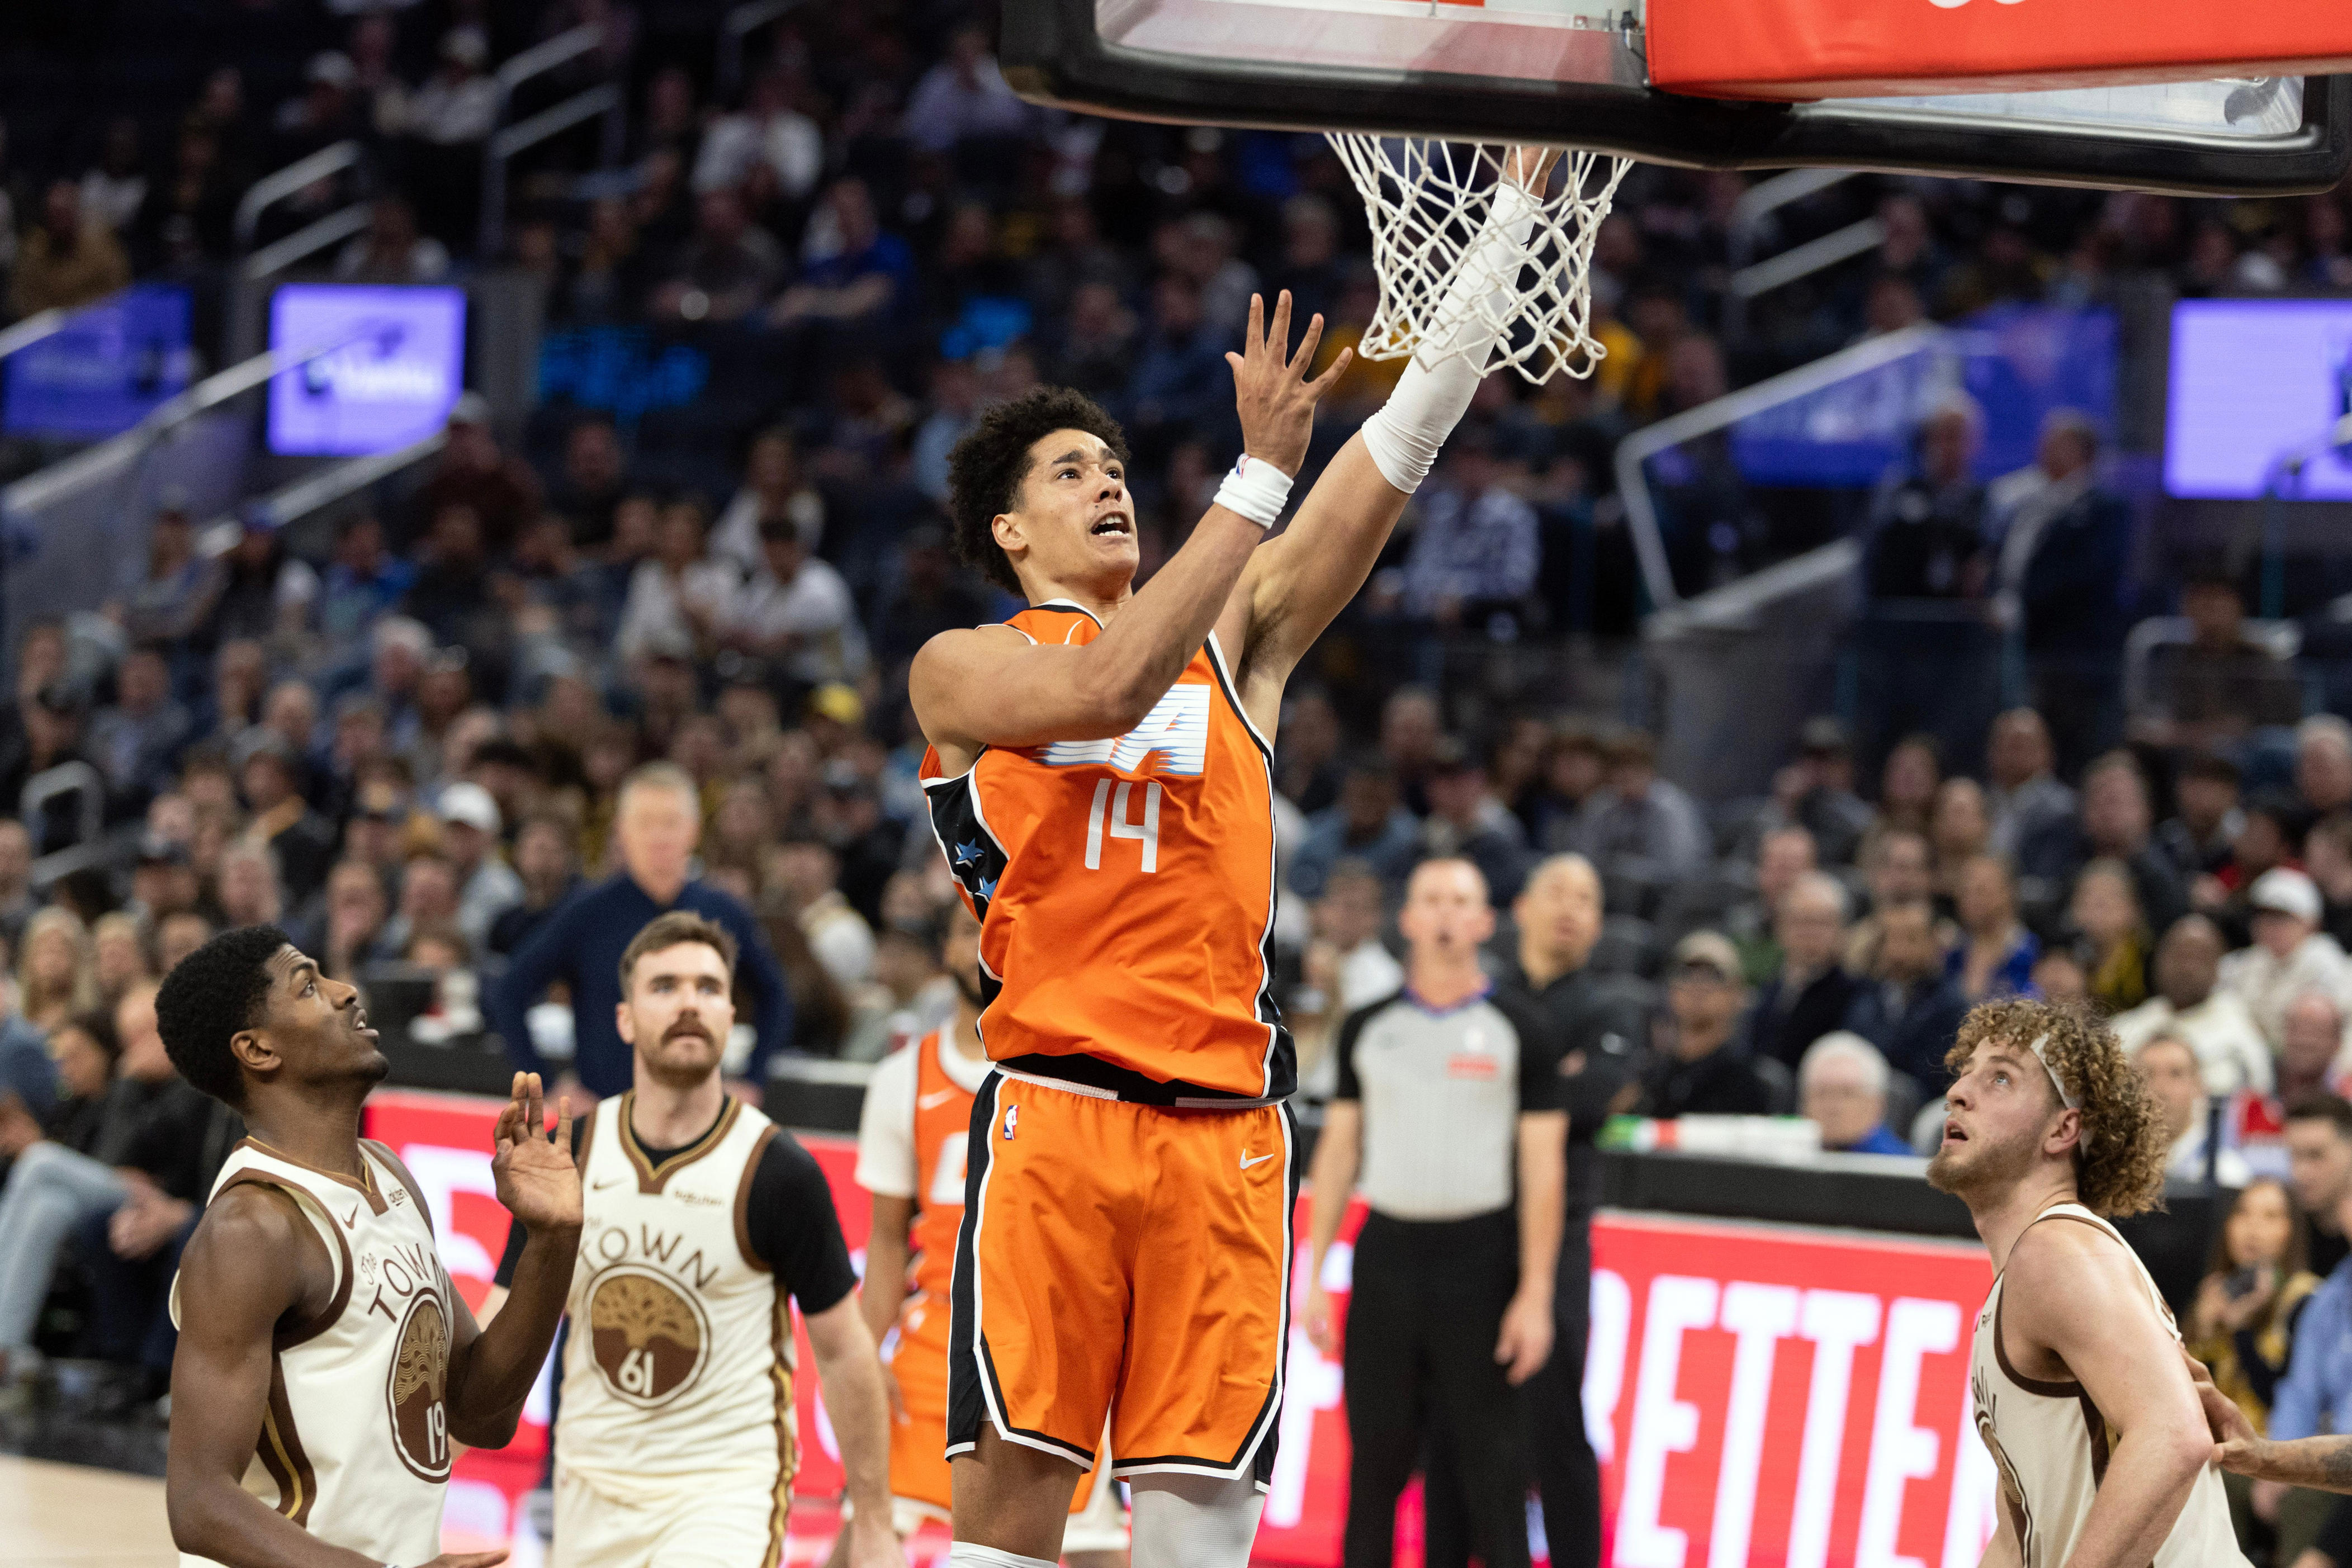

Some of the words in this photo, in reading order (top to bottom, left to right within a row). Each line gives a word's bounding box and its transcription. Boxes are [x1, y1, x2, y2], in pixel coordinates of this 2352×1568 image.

[1030, 683, 1211, 776] A
[1085, 778, 1162, 873] 14
[618, 1348, 654, 1397] 61
[427, 1401, 446, 1464] 19
